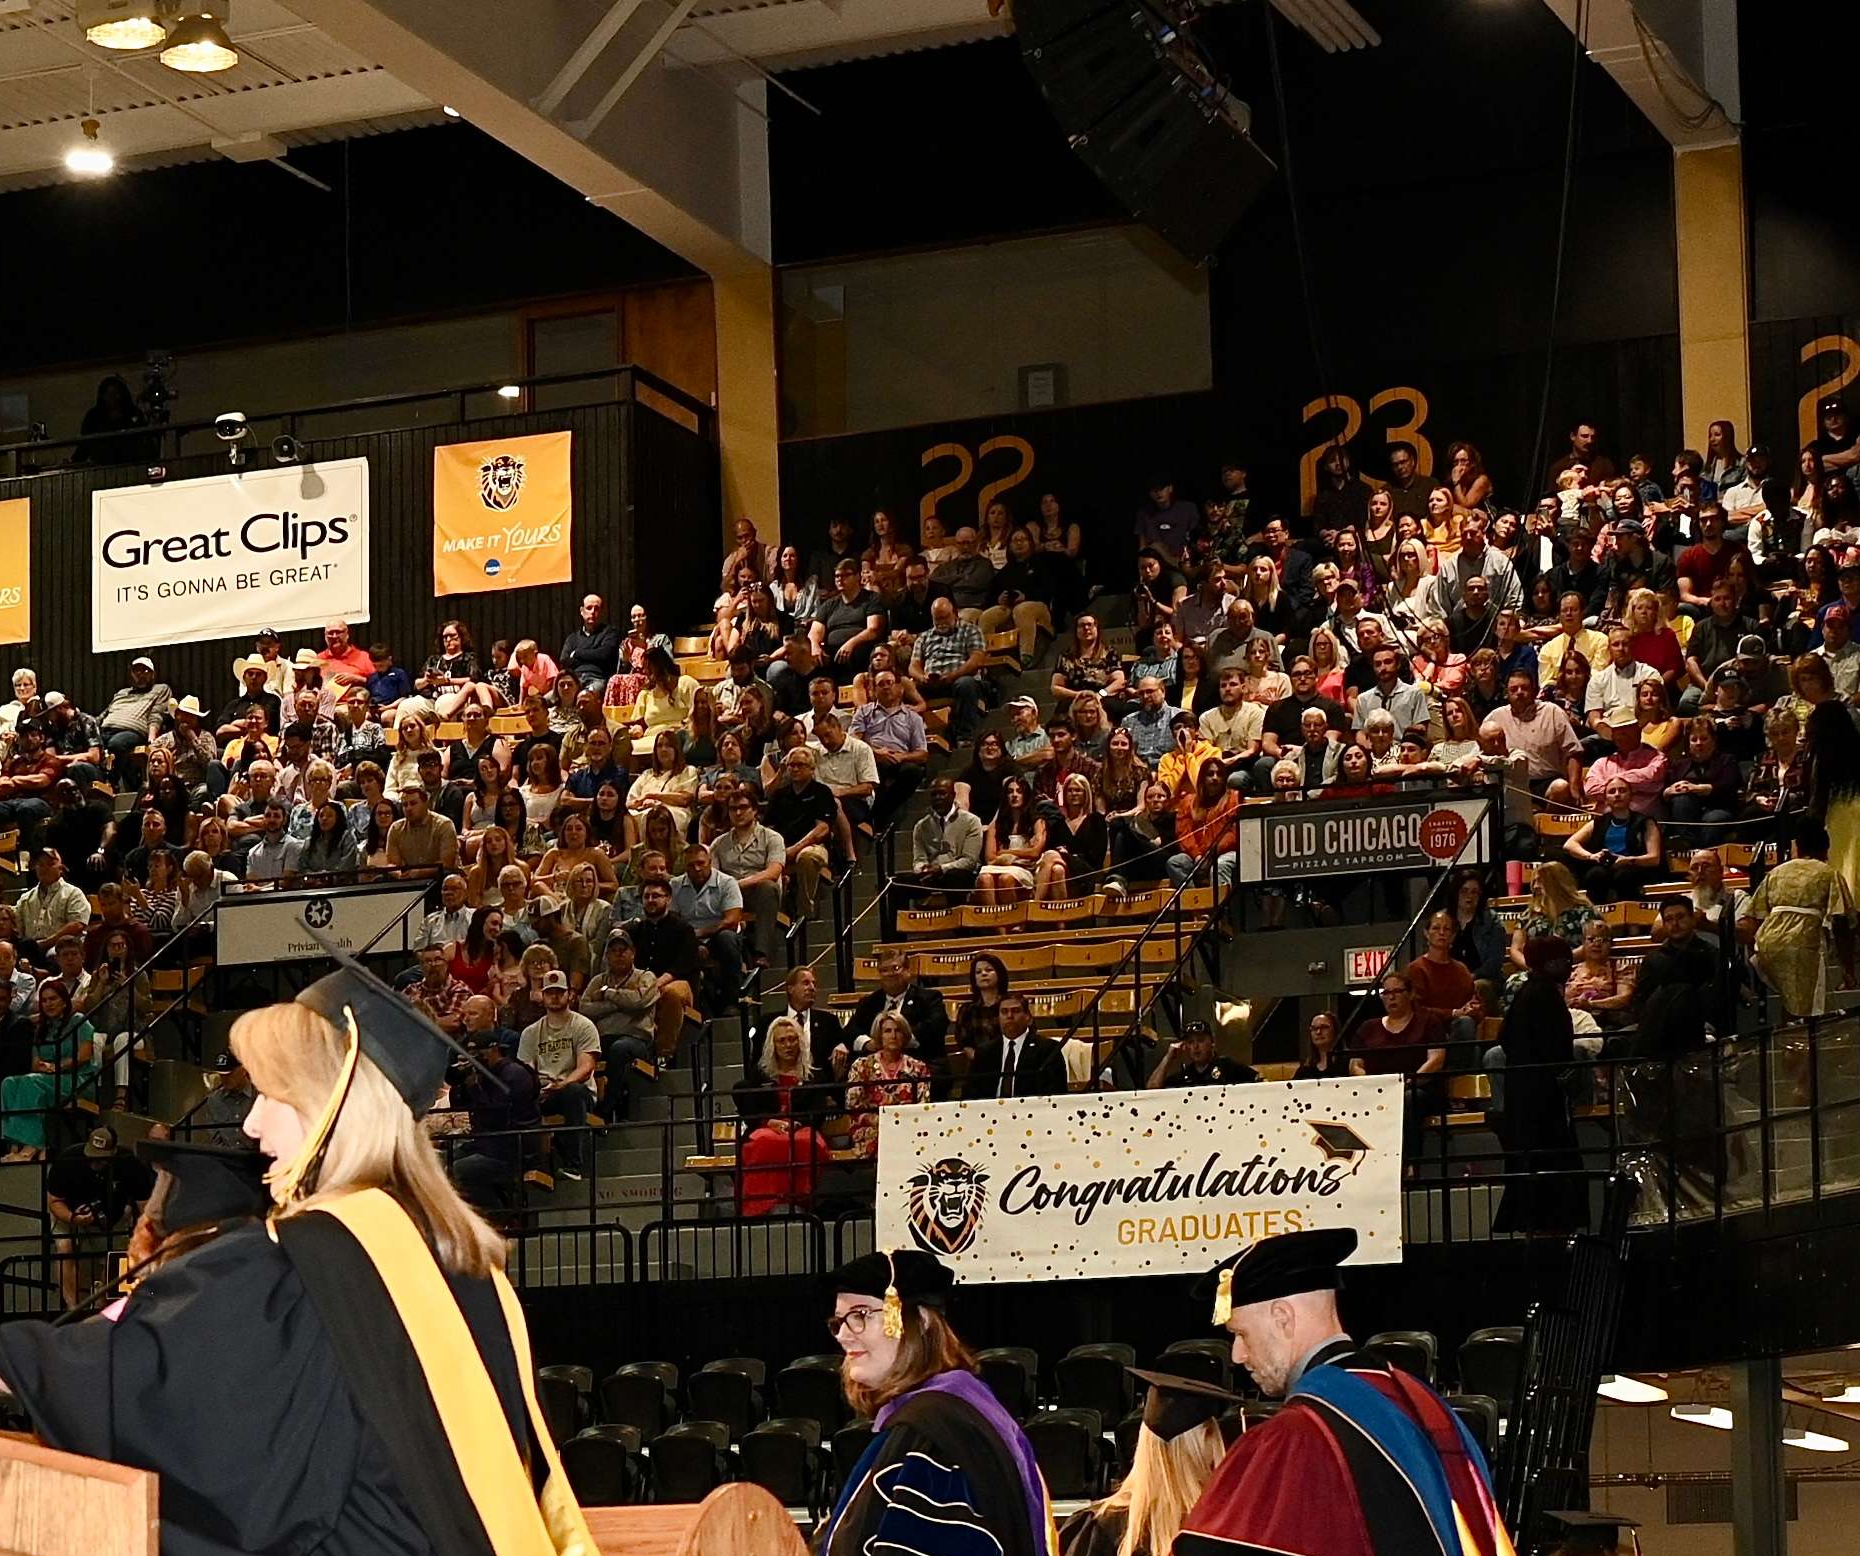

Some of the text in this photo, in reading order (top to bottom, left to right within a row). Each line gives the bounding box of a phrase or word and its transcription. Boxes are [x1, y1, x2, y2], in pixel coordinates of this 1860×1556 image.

[1298, 387, 1433, 518] 23
[920, 435, 1034, 546] 22
[102, 511, 350, 569] Great Clips
[442, 521, 562, 554] MAKE IT YOURS
[116, 564, 333, 603] IT'S GONNA BE GREAT
[1274, 811, 1421, 859] OLD CHICAGO
[1430, 832, 1456, 849] 1976
[1293, 853, 1404, 870] PIZZA & TAPROOM
[1354, 951, 1387, 978] EXIT
[998, 1152, 1345, 1226] Congratulations
[1117, 1209, 1303, 1246] GRADUATES
